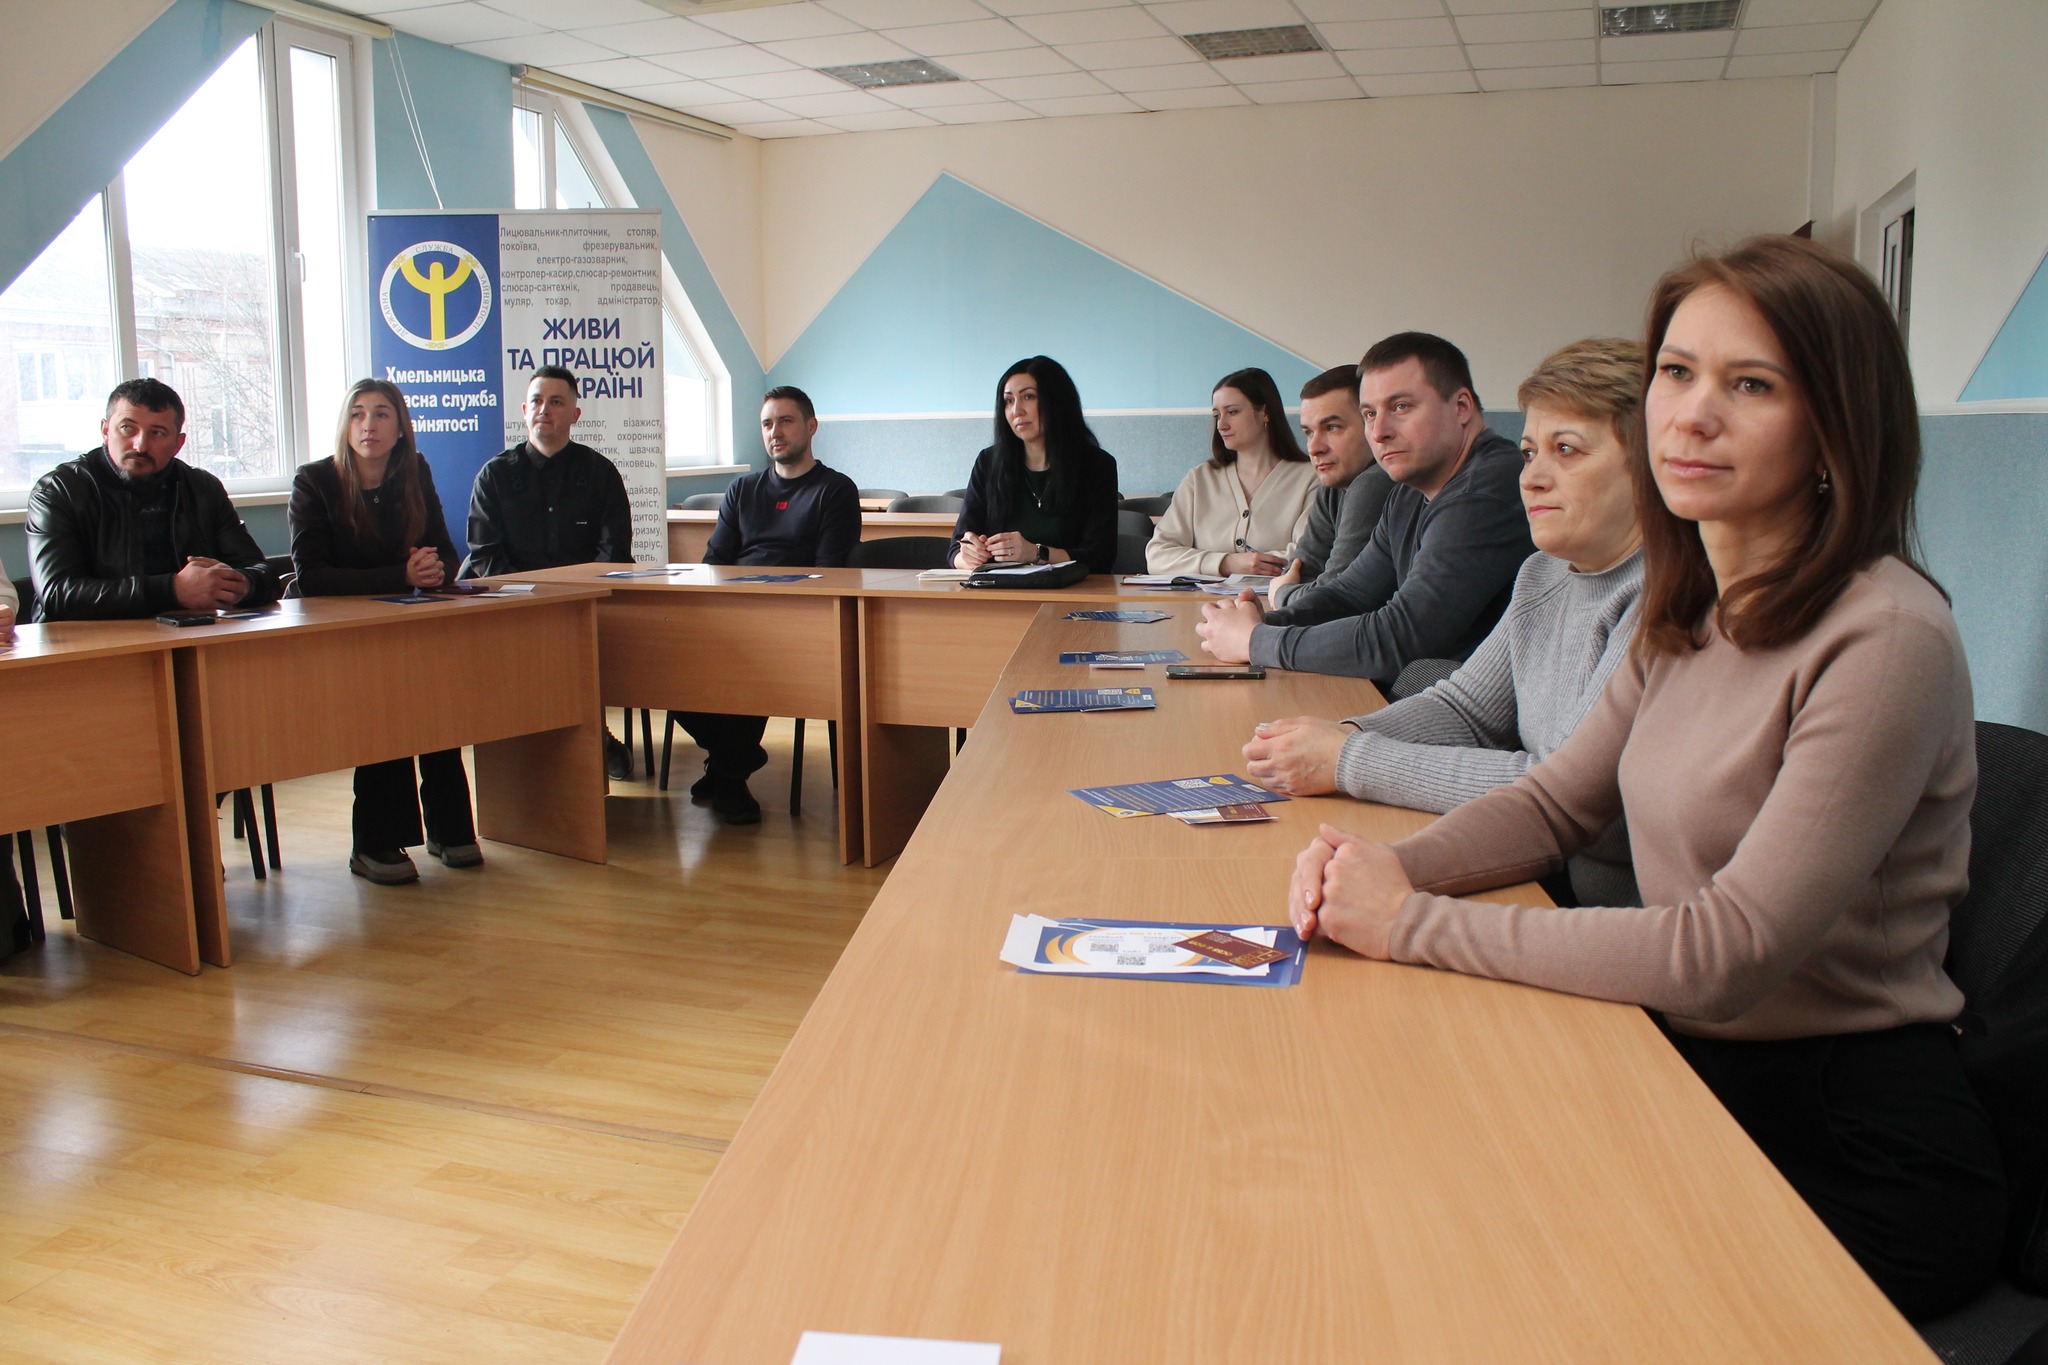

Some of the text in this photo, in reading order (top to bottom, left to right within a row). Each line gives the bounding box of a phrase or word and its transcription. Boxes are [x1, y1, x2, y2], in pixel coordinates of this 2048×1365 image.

[500, 227, 659, 238] Лицювальник-плиточник, столяр,
[415, 243, 454, 254] СЛУЖБА
[500, 240, 658, 252] покоївка, фрезерувальник,
[536, 255, 629, 266] електро-газозварник,
[501, 281, 660, 293] слюсар-сантехнік, продавець,
[504, 296, 661, 309] муляр, токар, адміністратор,
[382, 292, 408, 337] ДЕРЖАВНА
[543, 317, 620, 340] ЖИВИ
[507, 341, 655, 373] ТА ПРАЦЮЙ
[385, 366, 486, 386] Хмельницька
[575, 372, 643, 399] КРАЇНІ
[403, 389, 497, 411] асна служба
[411, 414, 479, 432] айнятості
[623, 418, 662, 428] візажист,
[570, 433, 606, 443] хгалтер,
[617, 433, 663, 443] охоронник
[629, 446, 663, 455] швачка,
[612, 458, 658, 469] бліковець,
[630, 499, 660, 509] номіст,
